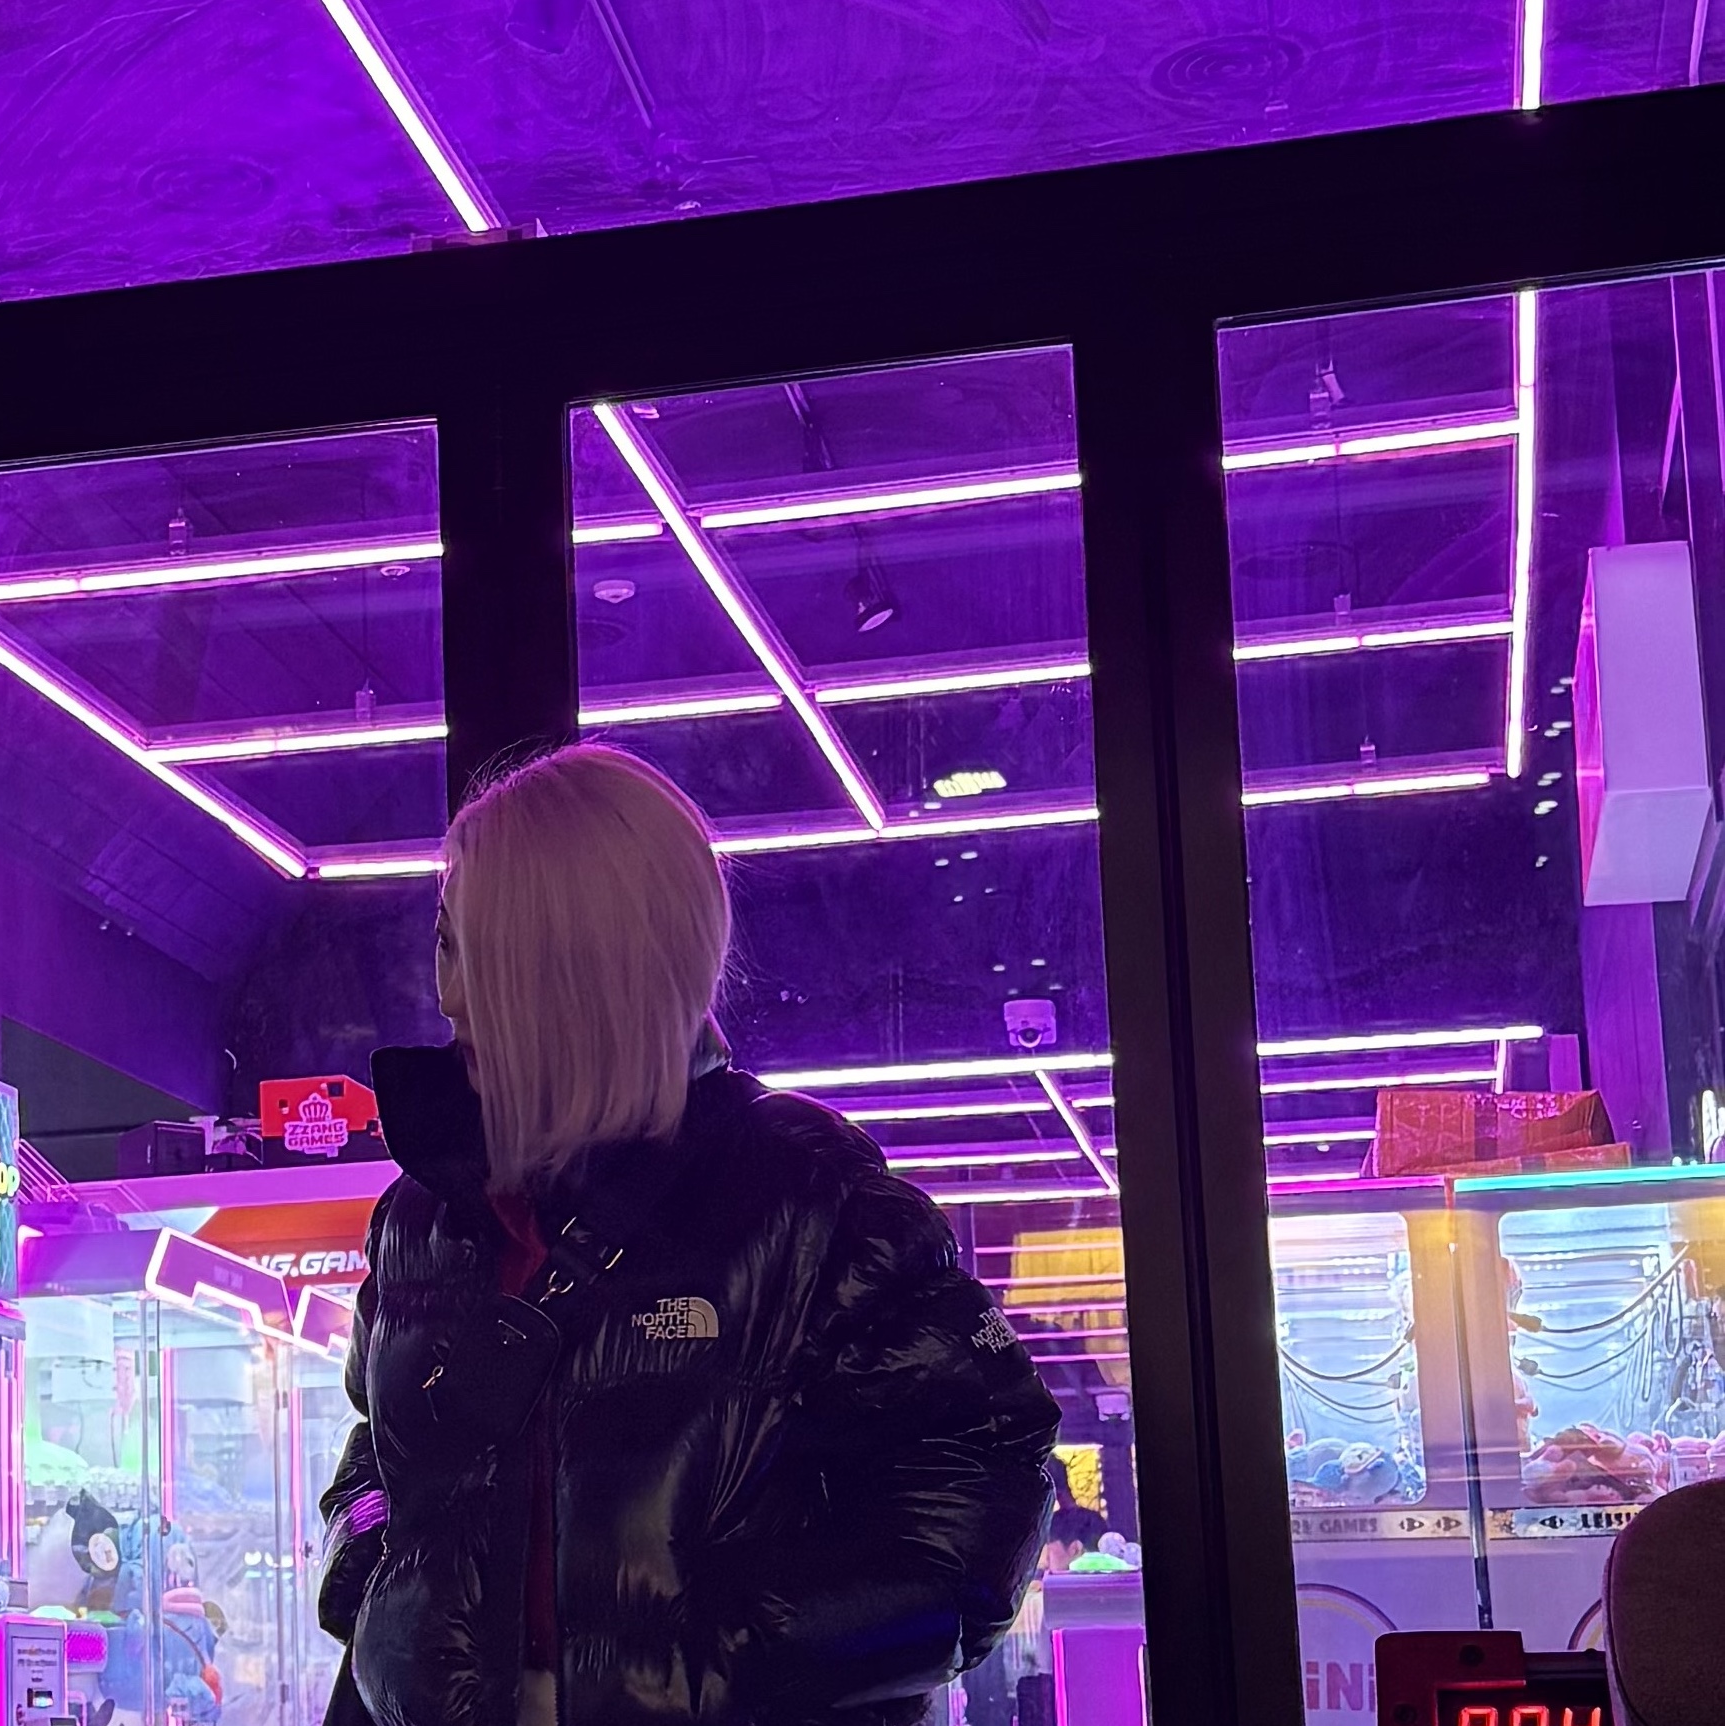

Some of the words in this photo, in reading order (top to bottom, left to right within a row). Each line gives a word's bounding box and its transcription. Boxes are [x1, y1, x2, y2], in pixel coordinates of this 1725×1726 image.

[288, 1120, 345, 1136] ZZANG
[288, 1134, 345, 1148] GAMES
[656, 1296, 689, 1312] THE
[631, 1311, 688, 1328] NORTH
[645, 1324, 687, 1340] FACE
[1320, 1517, 1378, 1534] GAMES
